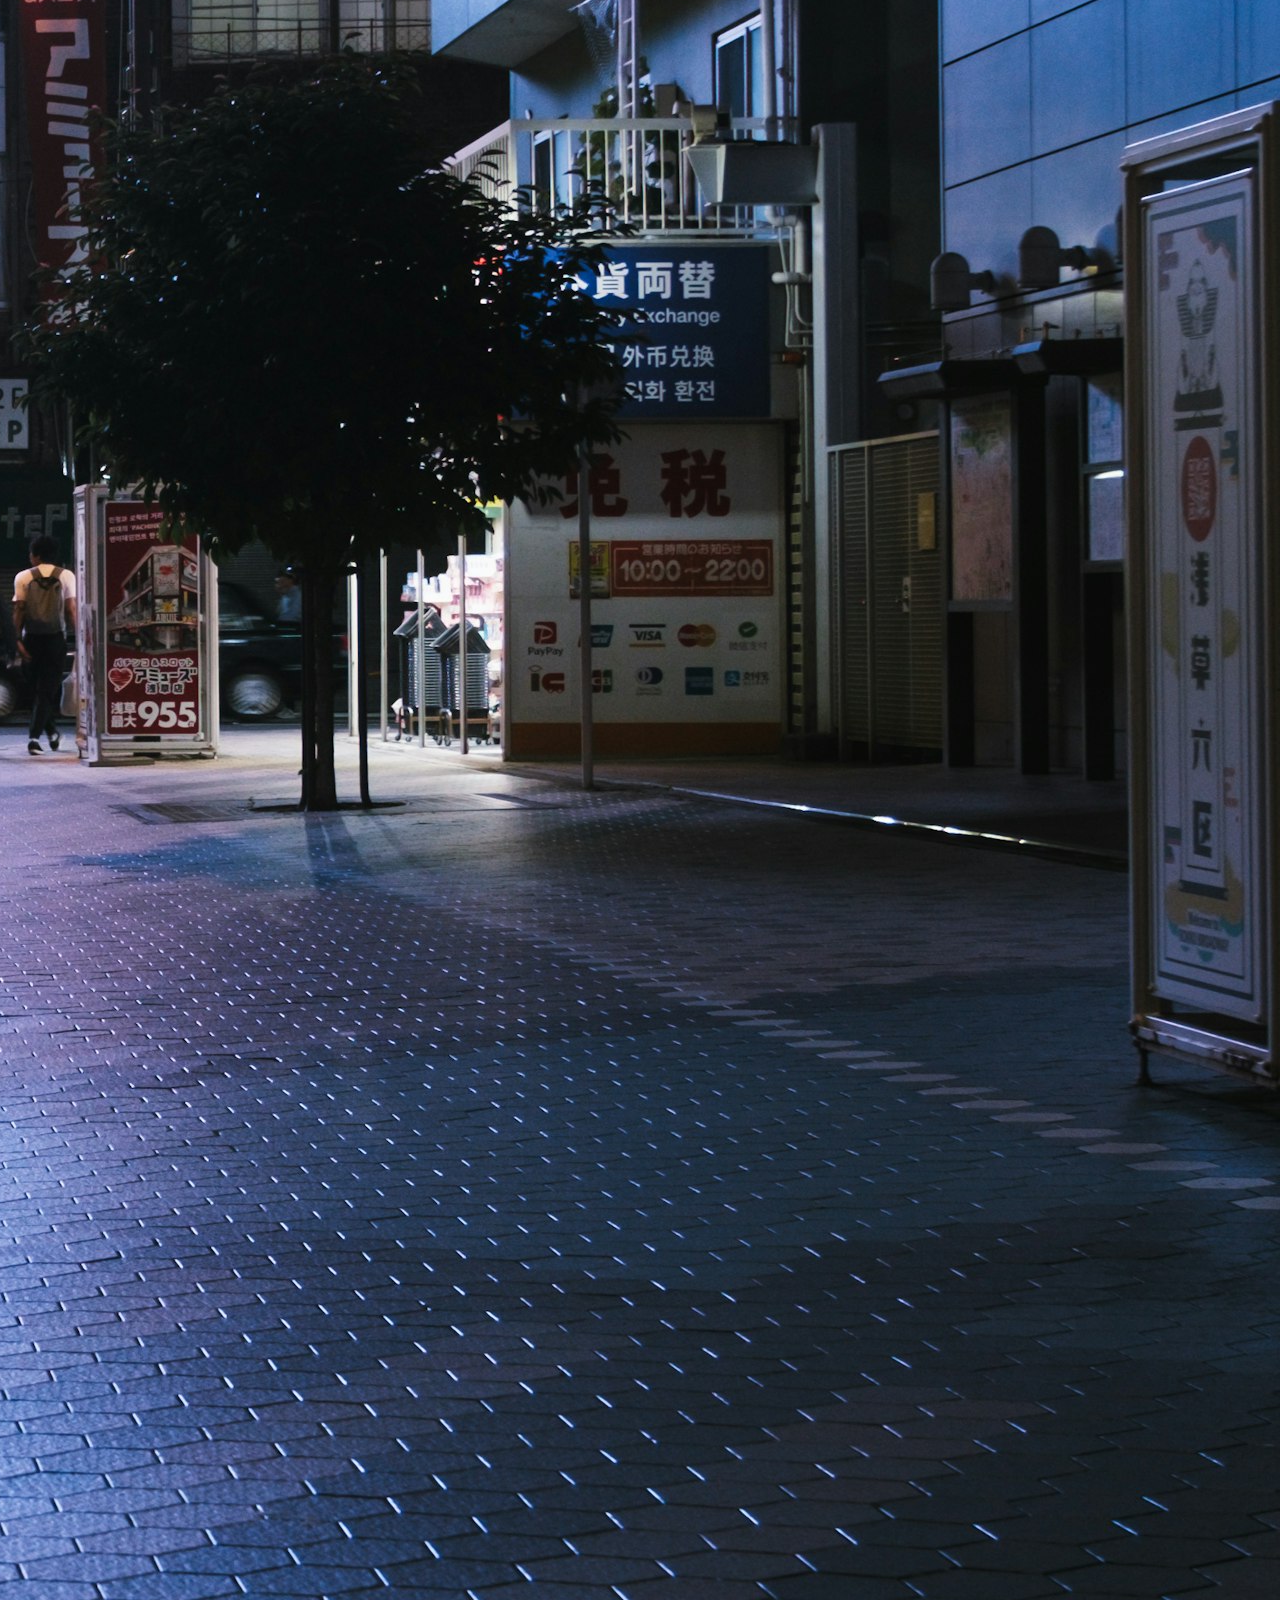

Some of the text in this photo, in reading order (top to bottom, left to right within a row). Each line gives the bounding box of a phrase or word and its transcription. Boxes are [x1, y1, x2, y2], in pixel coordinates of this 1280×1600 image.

[621, 344, 715, 368] 外币兑换
[673, 379, 716, 402] 환전
[559, 447, 731, 520] 免税
[641, 543, 744, 557] 営業時間のお知らせ
[634, 630, 663, 642] VISA
[527, 646, 564, 657] PayPay
[133, 667, 198, 684] アミューズ
[137, 700, 197, 729] 955
[1190, 550, 1213, 858] 浅草六区
